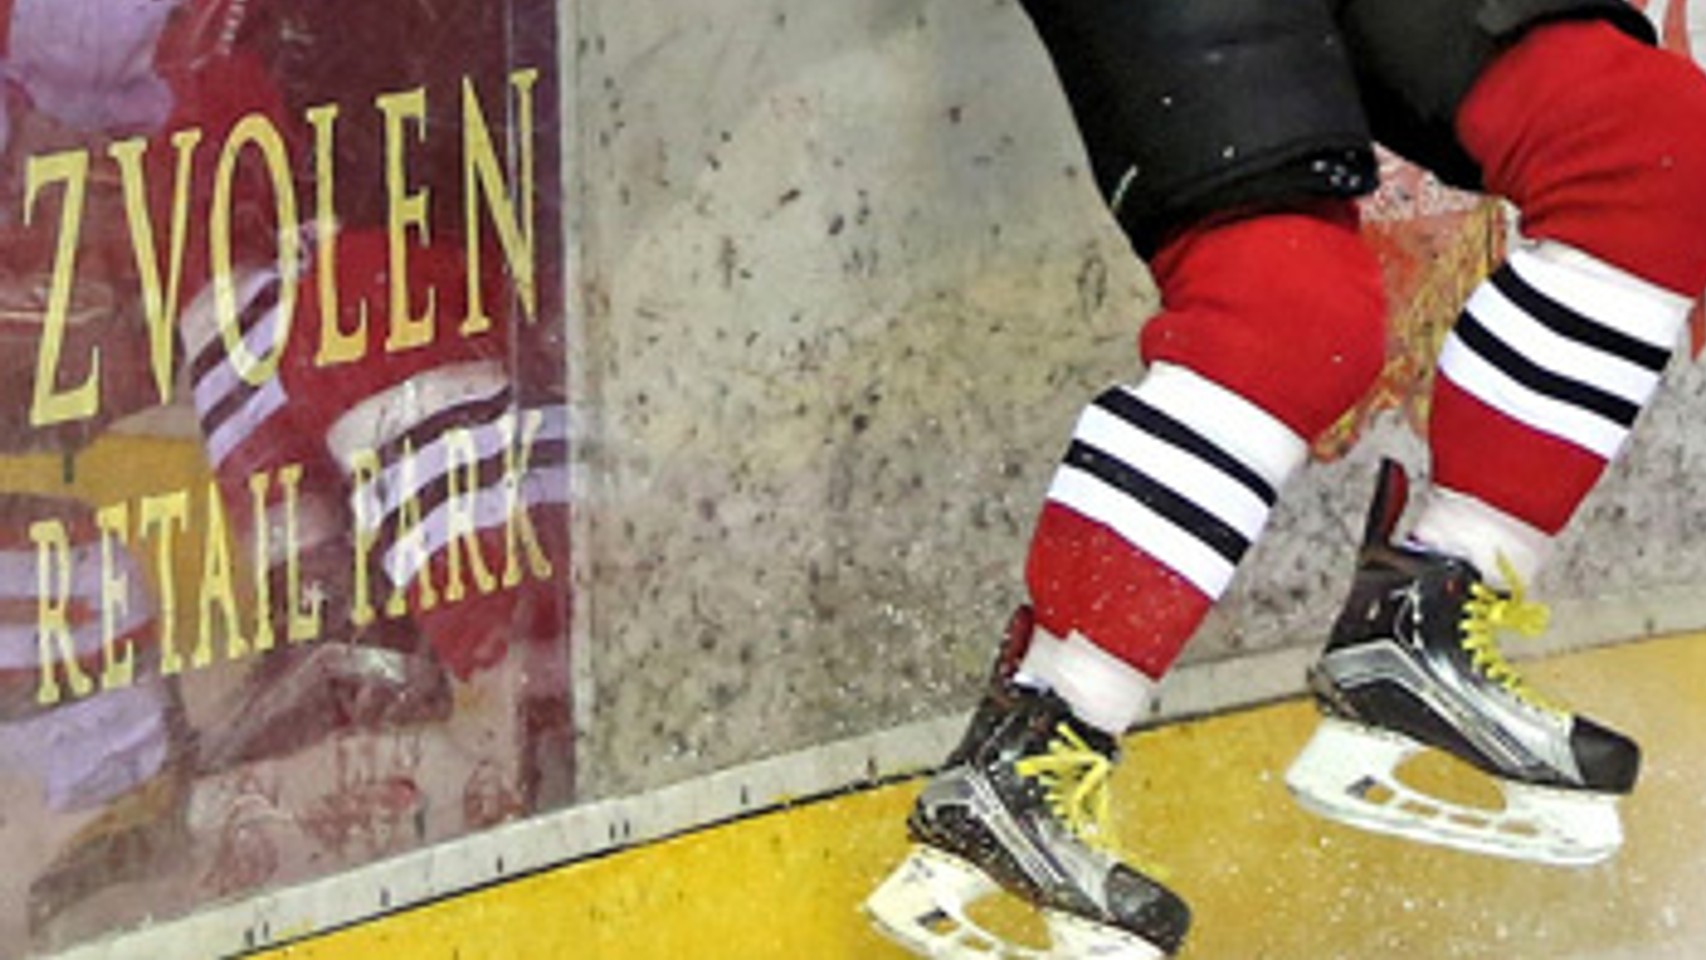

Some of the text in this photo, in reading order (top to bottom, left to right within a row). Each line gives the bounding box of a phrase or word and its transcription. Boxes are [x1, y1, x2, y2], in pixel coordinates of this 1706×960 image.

[22, 68, 540, 428] ZVOLEN
[29, 406, 555, 706] RETAIL PARK
